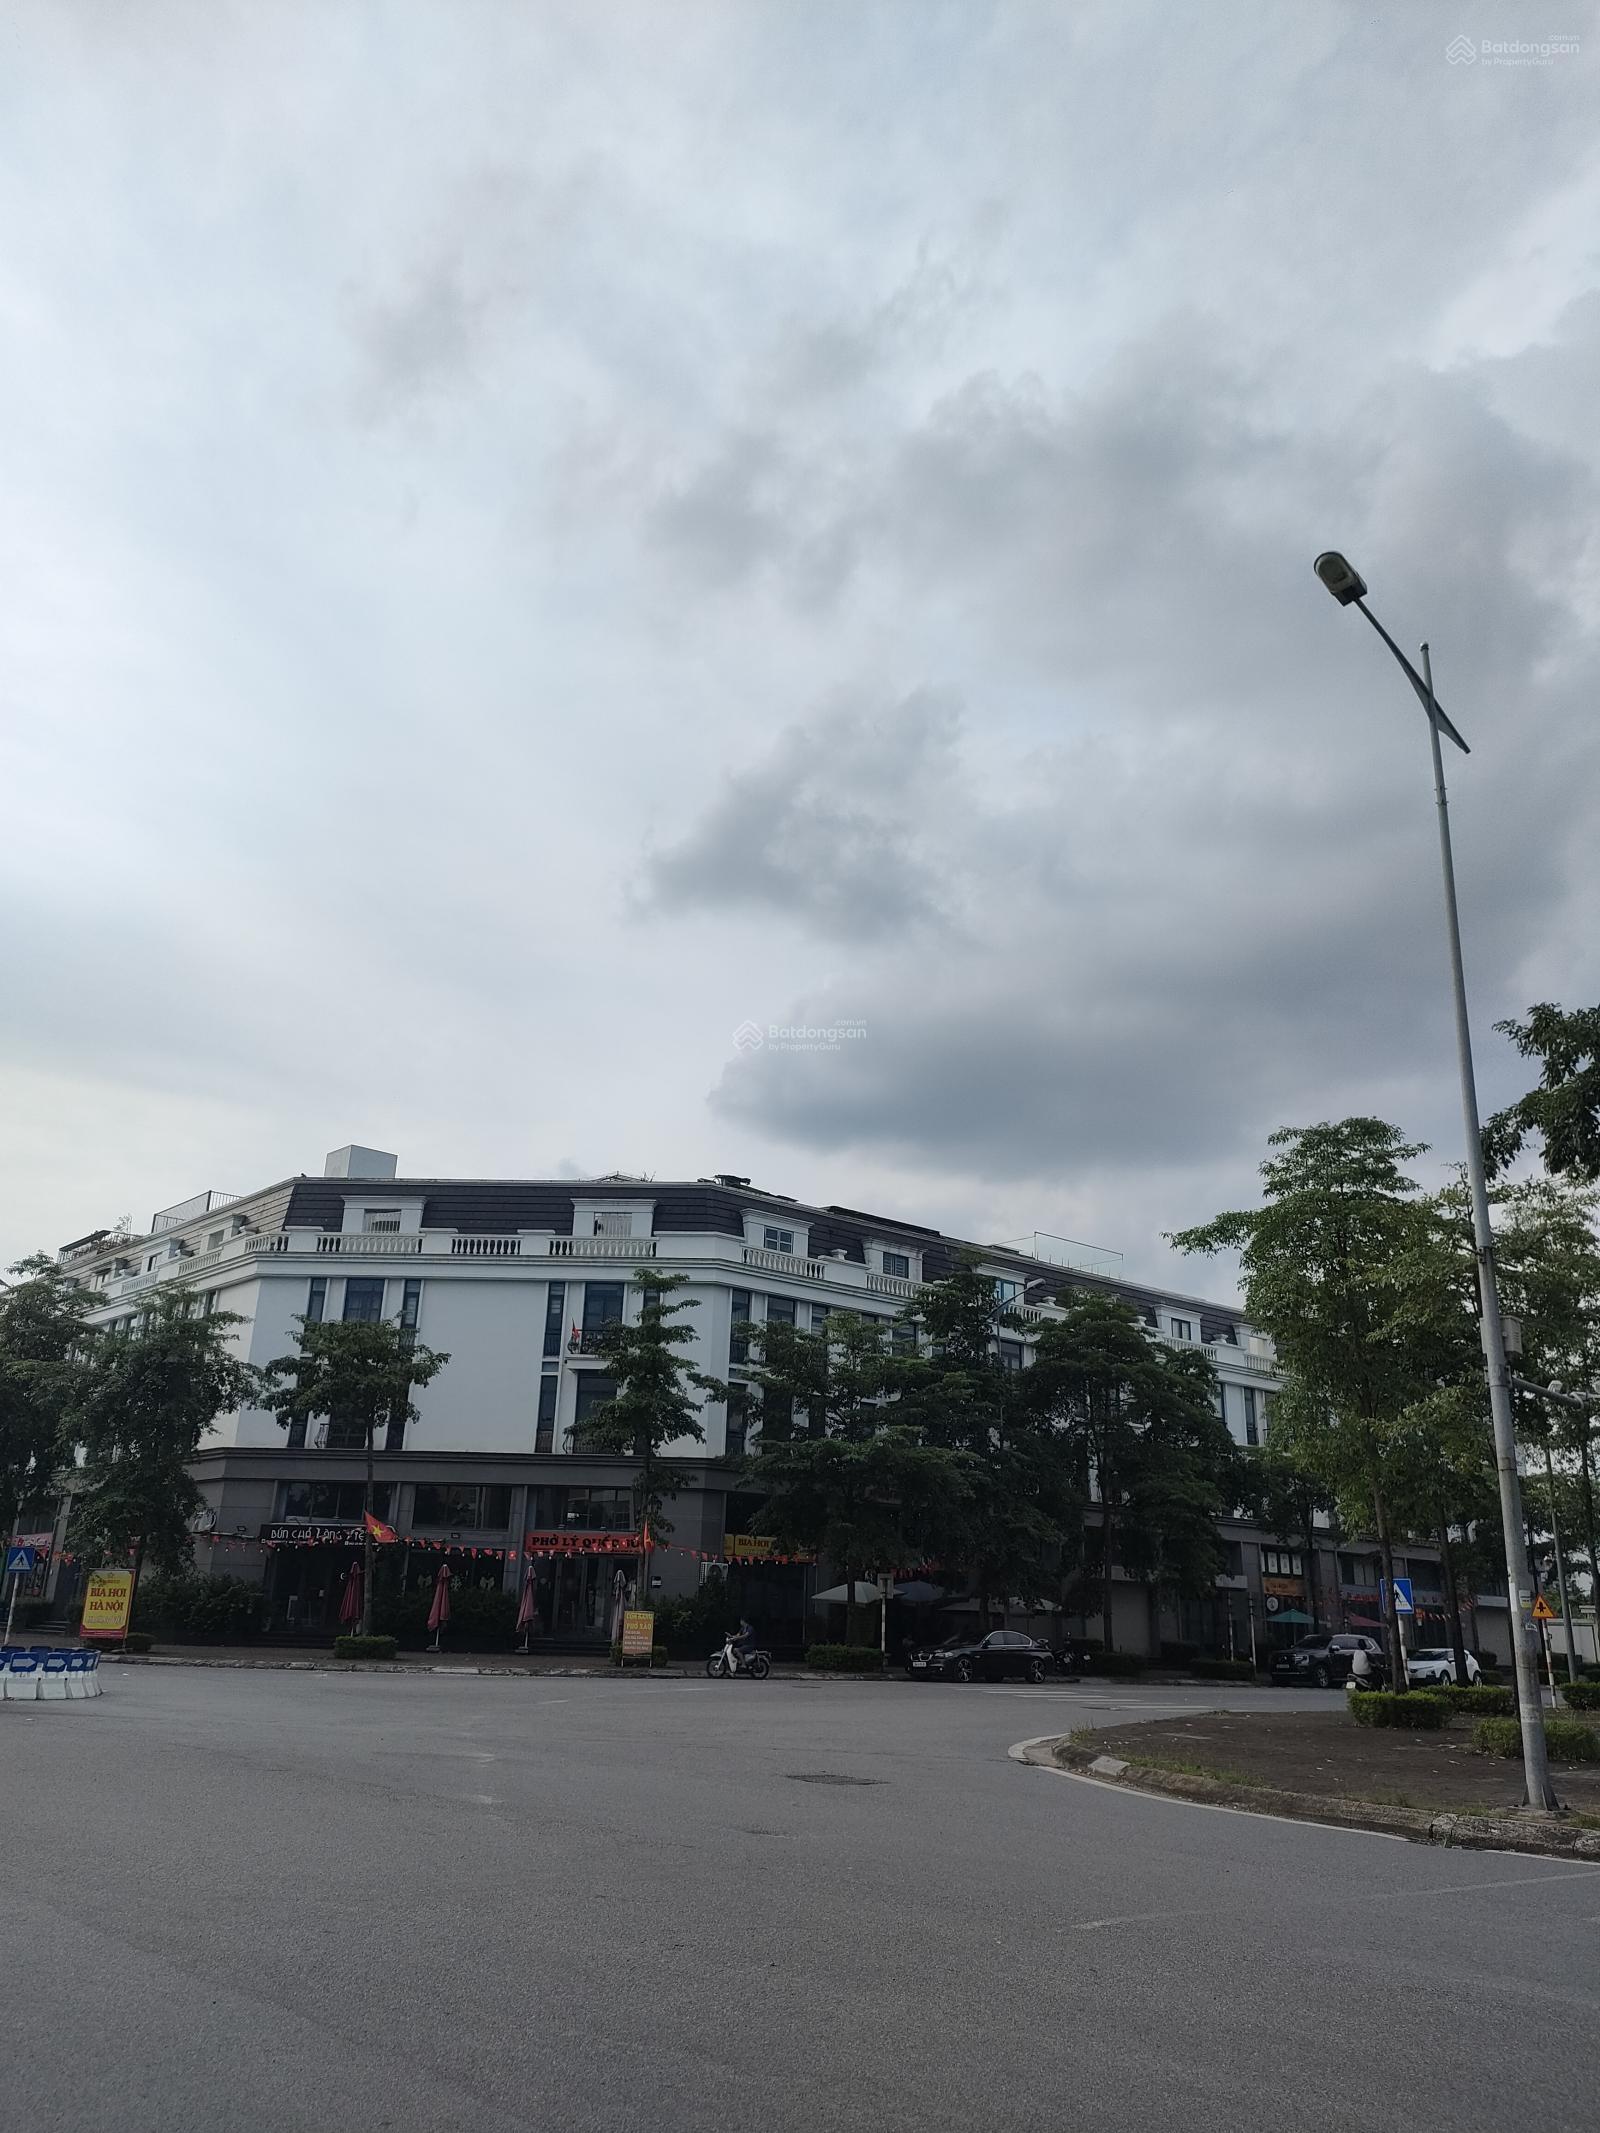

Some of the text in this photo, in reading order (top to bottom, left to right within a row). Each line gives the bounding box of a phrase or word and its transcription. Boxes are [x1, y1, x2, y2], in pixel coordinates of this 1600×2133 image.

[532, 1534, 559, 1546] PHỞ
[90, 1587, 106, 1597] BIA
[89, 1600, 124, 1613] HÀ NỘI
